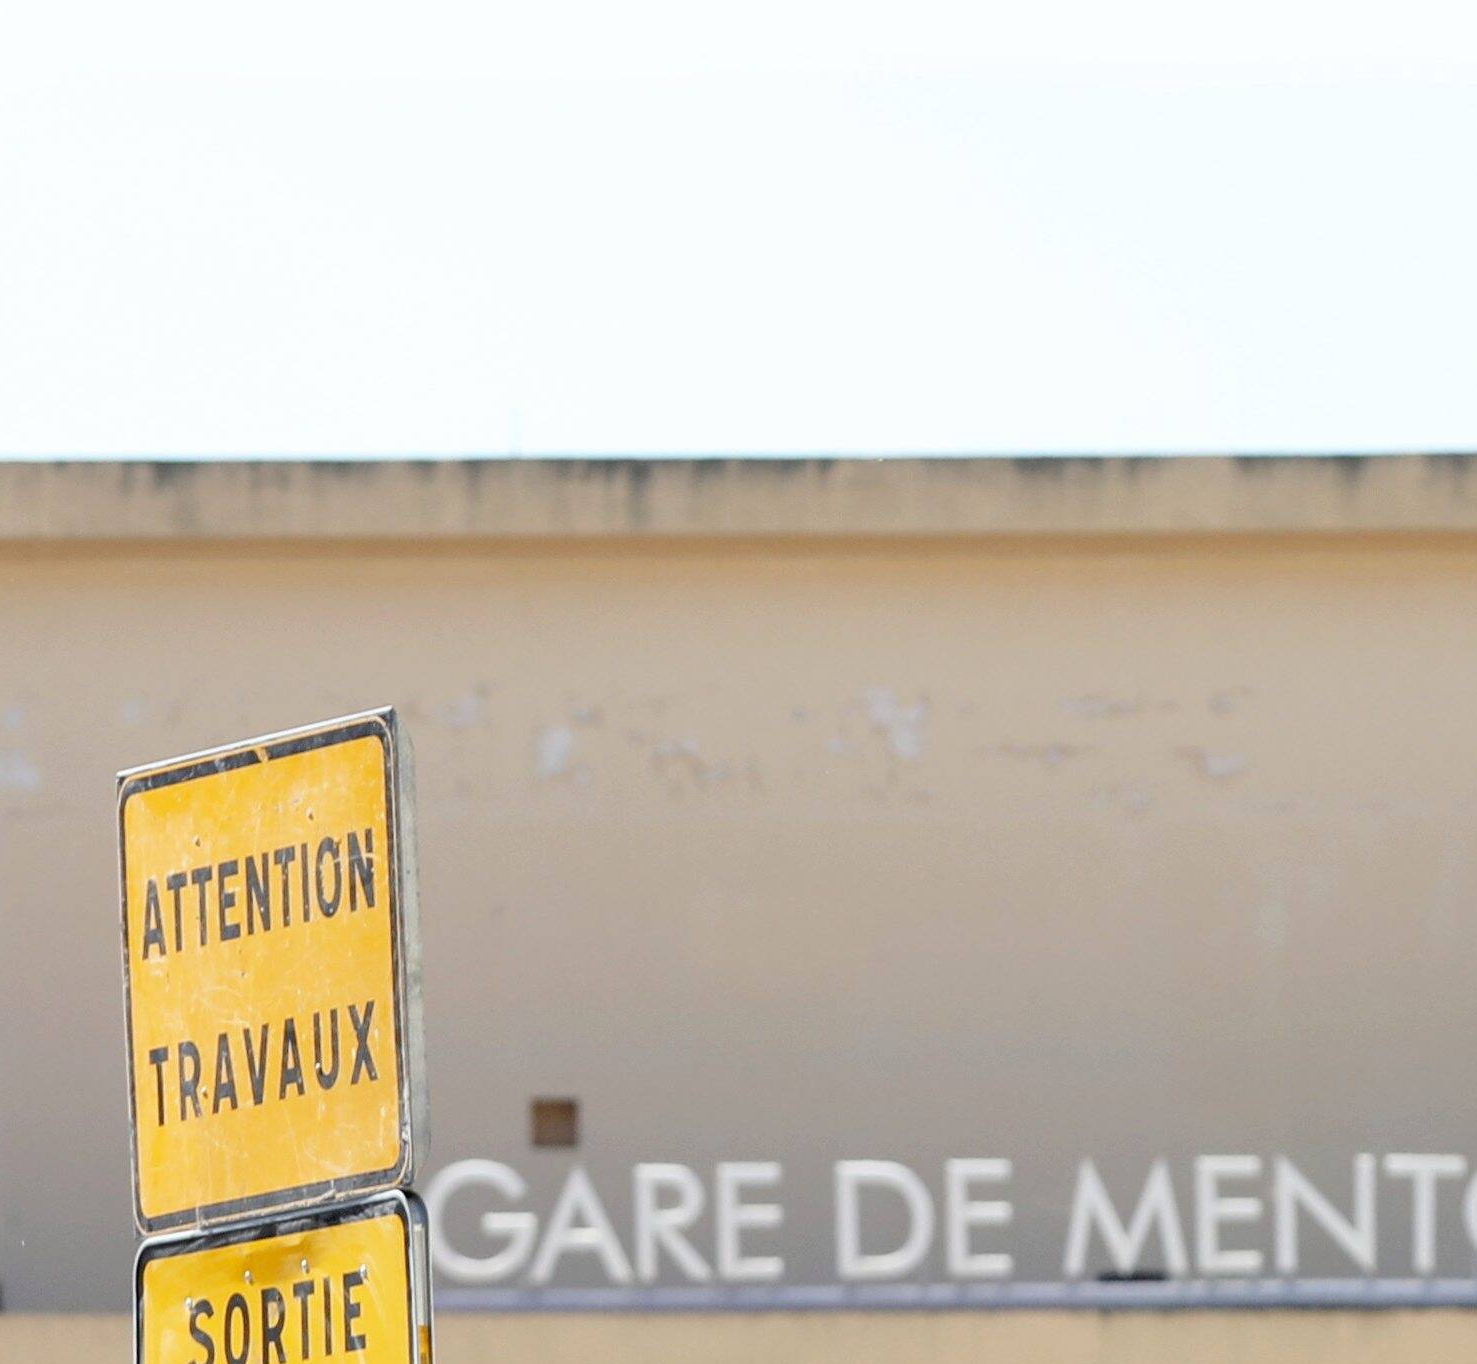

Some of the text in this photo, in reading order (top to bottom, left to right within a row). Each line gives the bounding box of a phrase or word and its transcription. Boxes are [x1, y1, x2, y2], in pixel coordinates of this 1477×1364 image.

[141, 828, 376, 960] ATTENTION
[149, 1000, 378, 1126] TRAVAUX
[429, 1155, 785, 1286] GARE
[833, 1156, 1013, 1279] DE
